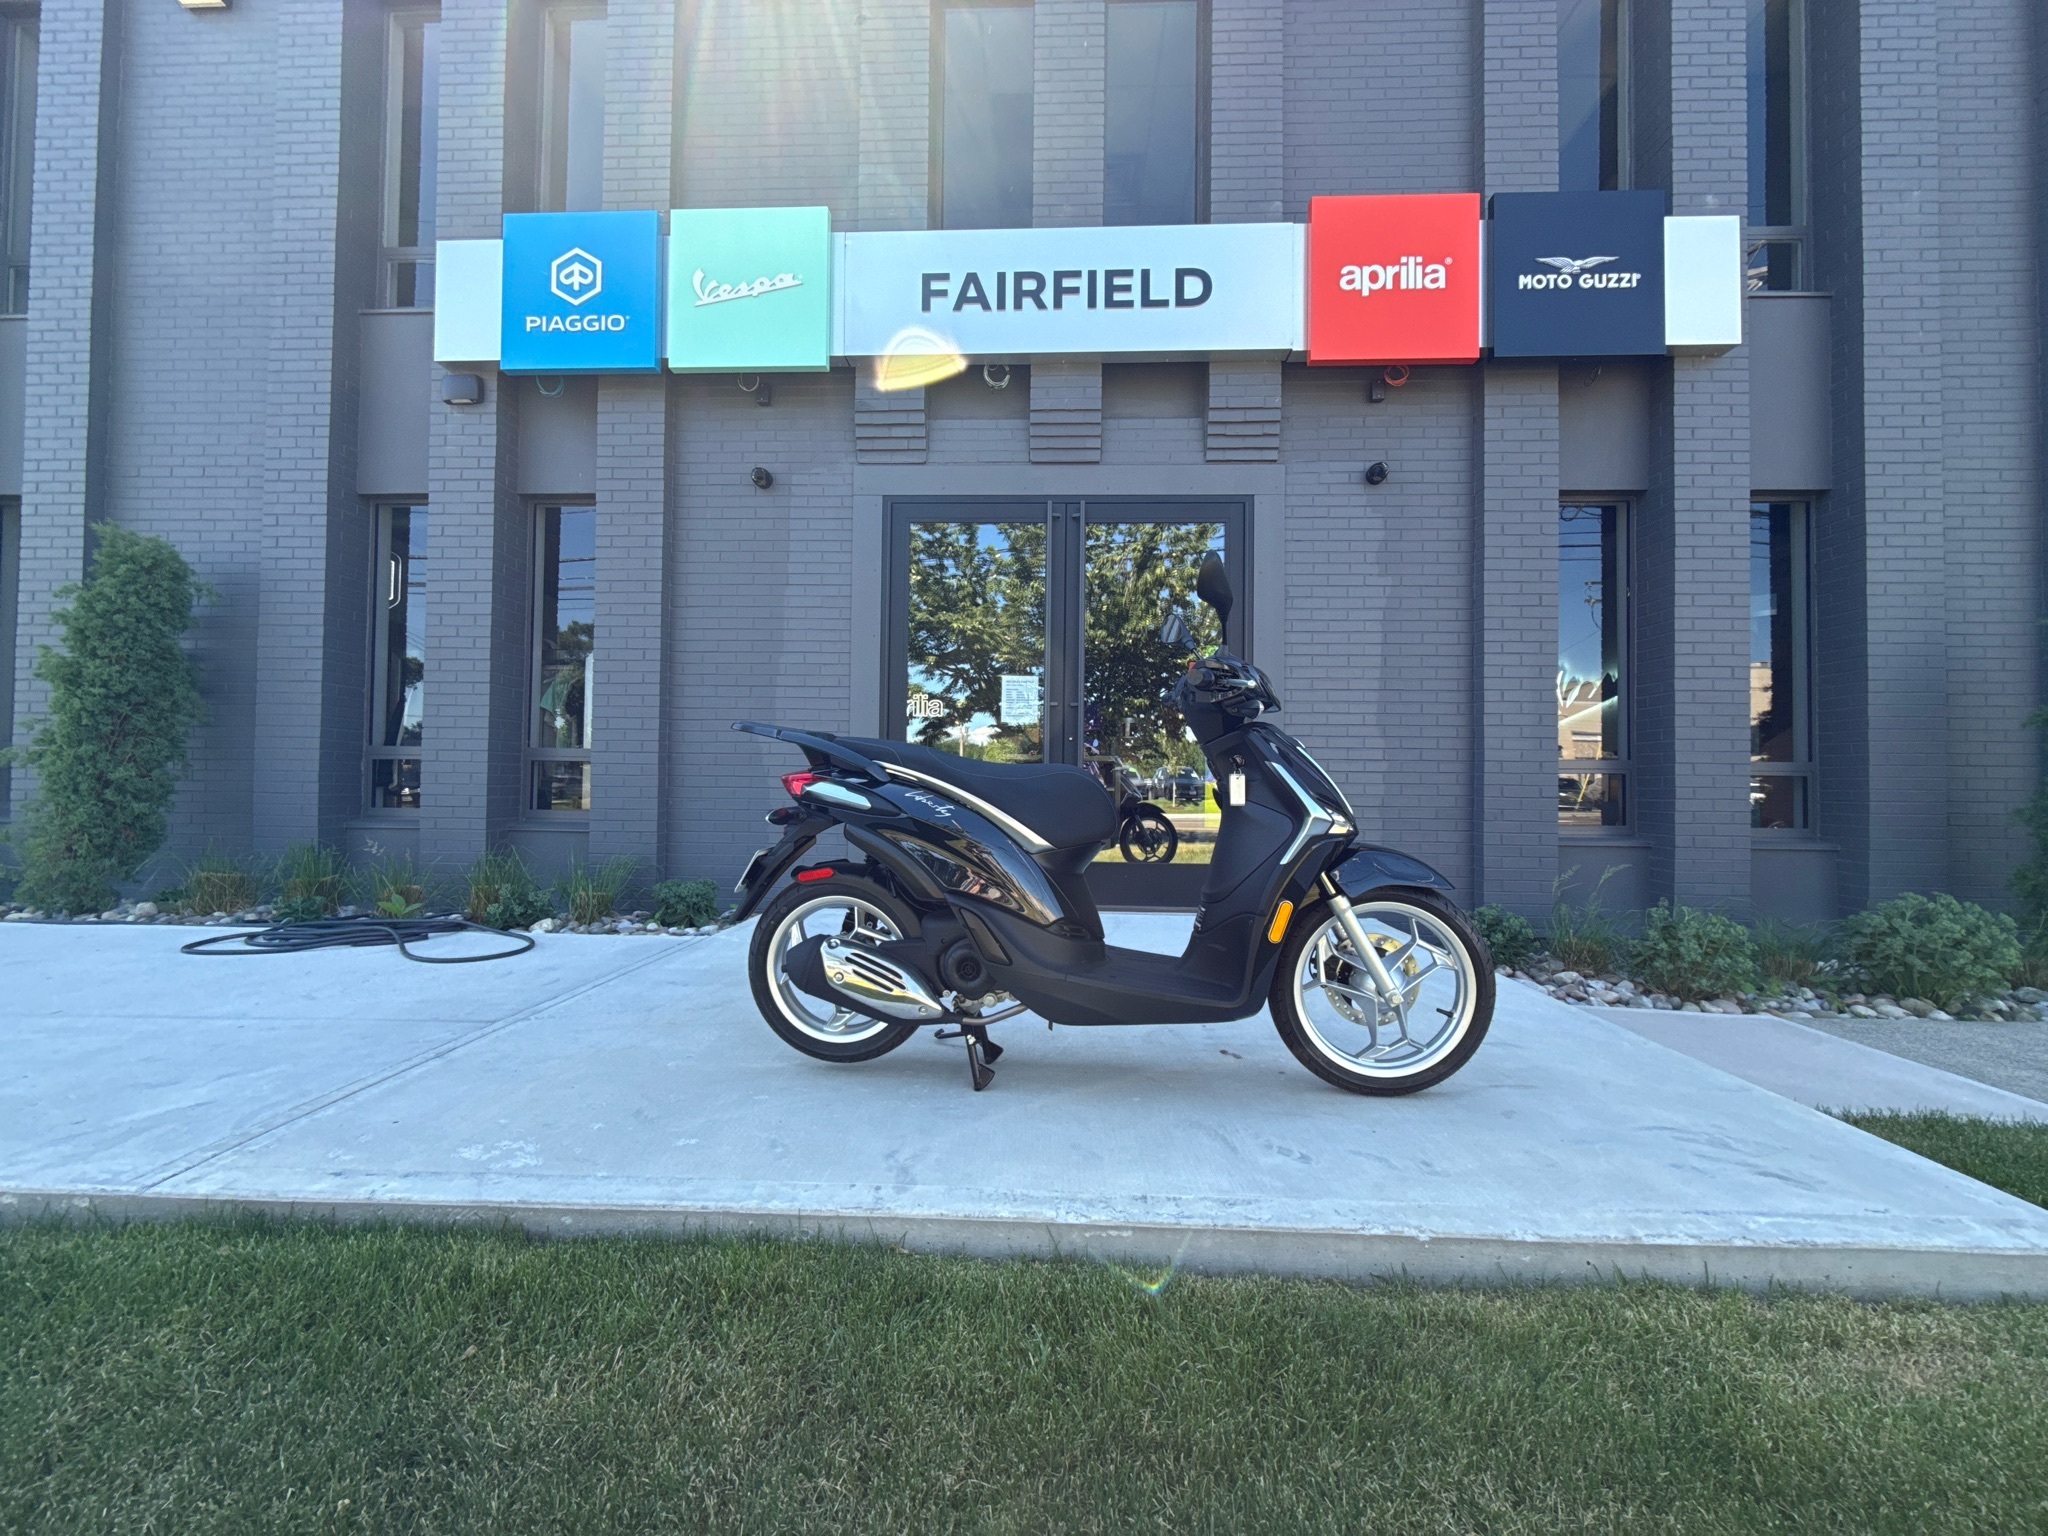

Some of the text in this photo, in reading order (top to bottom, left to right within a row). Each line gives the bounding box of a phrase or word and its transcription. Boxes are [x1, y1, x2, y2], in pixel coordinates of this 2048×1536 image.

[692, 267, 804, 307] Vespa
[921, 267, 1213, 313] FAIRFIELD
[1339, 255, 1447, 297] aprilia
[1518, 273, 1638, 290] MOTO GUZZI
[525, 314, 626, 333] PIAGGIO
